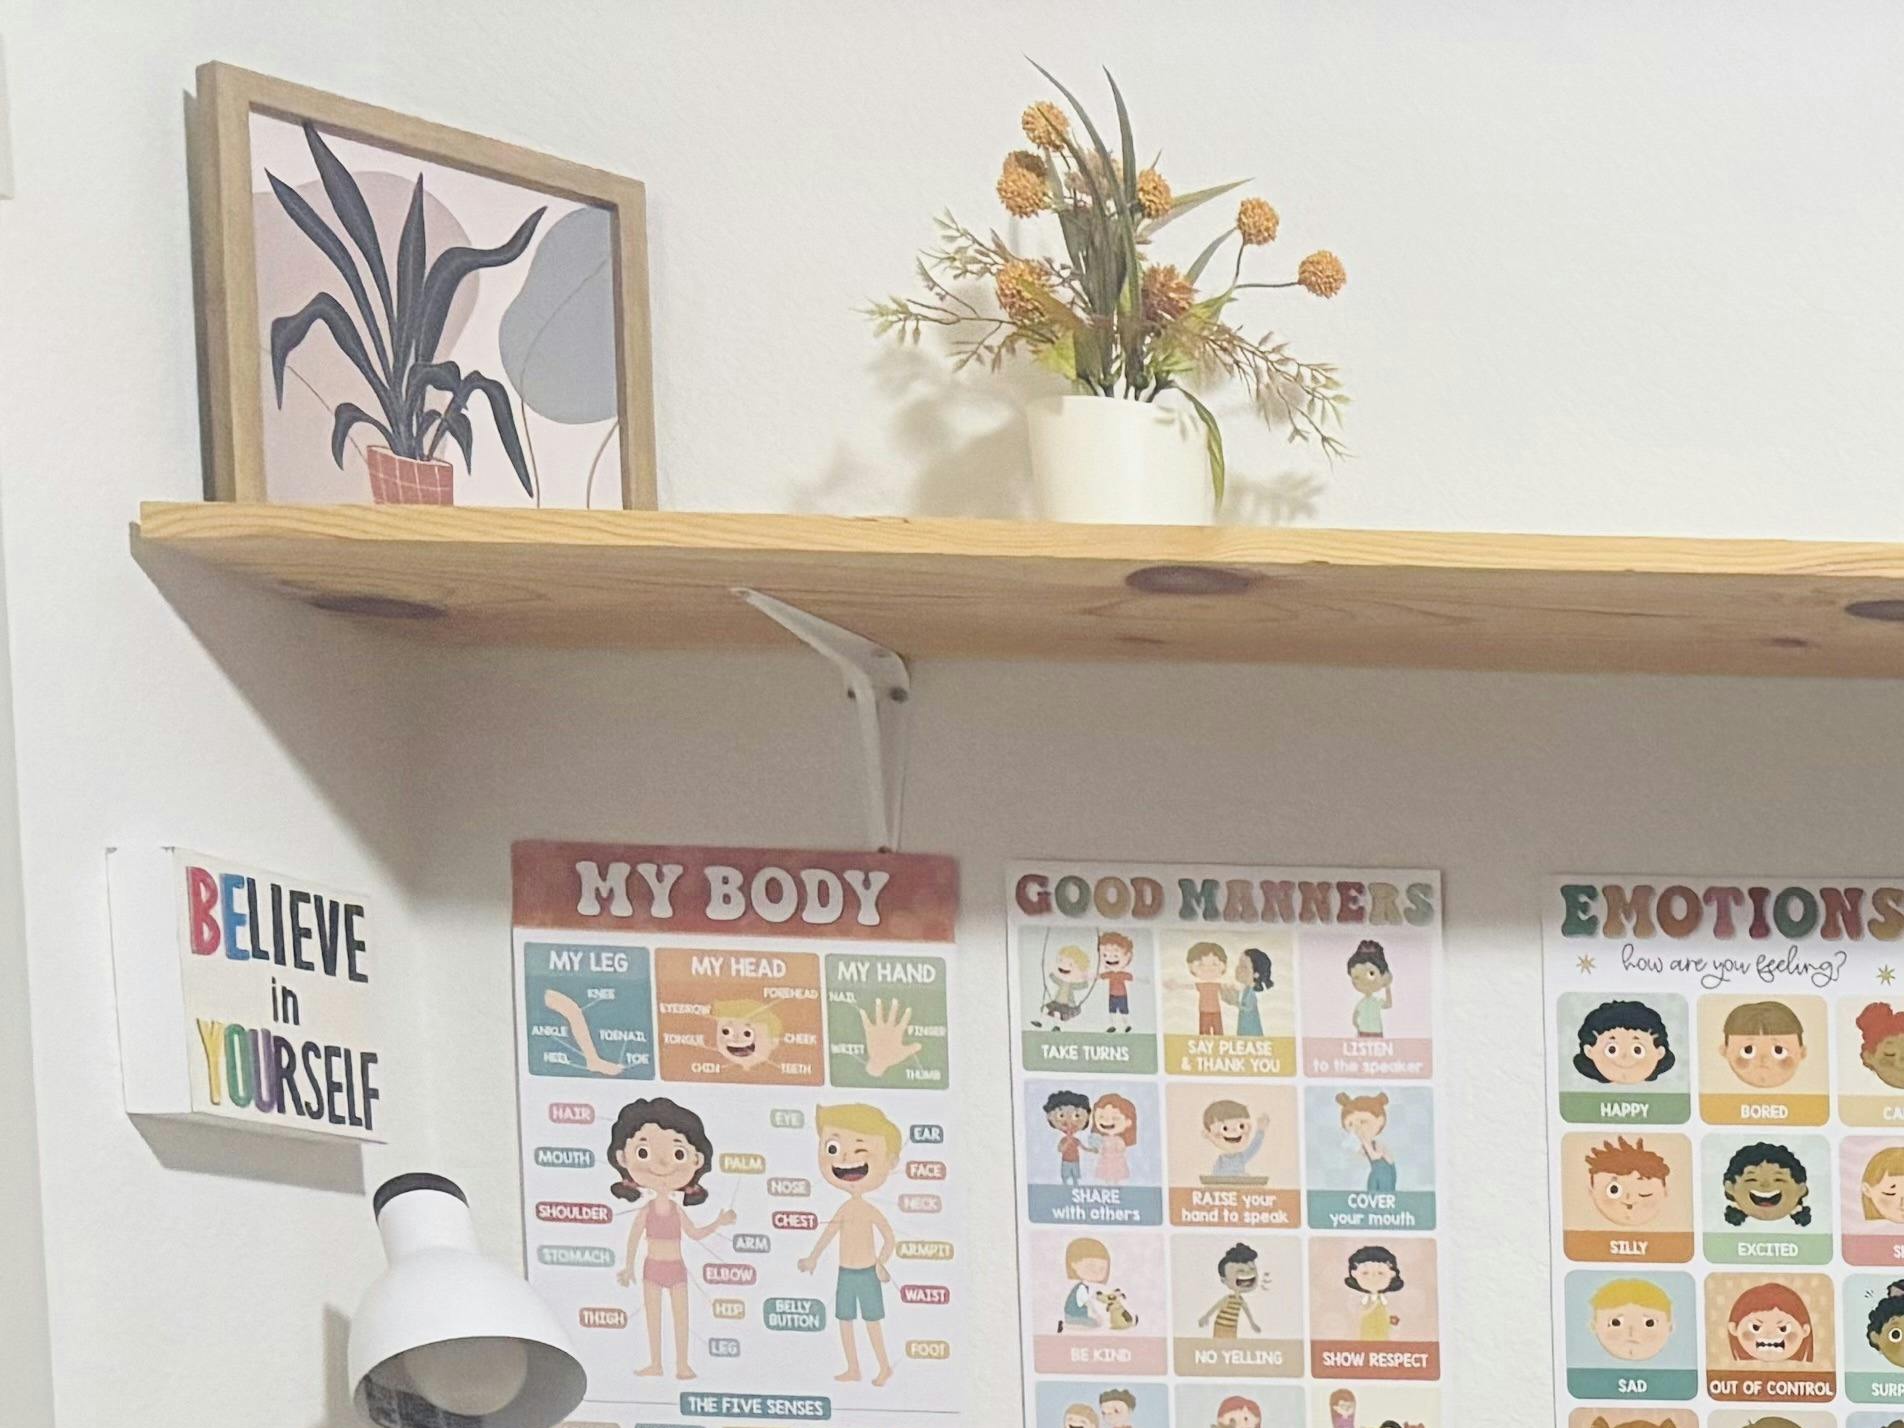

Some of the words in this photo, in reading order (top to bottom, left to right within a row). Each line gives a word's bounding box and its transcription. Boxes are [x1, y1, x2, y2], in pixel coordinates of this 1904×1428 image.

[575, 860, 684, 919] MY
[703, 865, 890, 926] BODY
[1015, 873, 1165, 918] GOOD
[1177, 878, 1435, 927] MANNERS
[186, 866, 369, 983] BELIEVE
[549, 952, 584, 972] MY
[590, 952, 629, 973] LEG
[691, 957, 726, 977] MY
[730, 958, 786, 978] HEAD
[838, 961, 869, 982] MY
[876, 963, 936, 984] HAND
[271, 976, 299, 1025] in
[1041, 1044, 1078, 1060] TAKE
[1083, 1046, 1129, 1061] TURNS
[196, 1018, 380, 1130] YOURSELF
[1600, 1103, 1649, 1118] HAPPY
[1741, 1104, 1788, 1119] BORED
[538, 1150, 591, 1165] MOUTH
[538, 1204, 608, 1221] SHOULDER
[775, 1213, 814, 1229] CHEST
[1609, 1241, 1648, 1256] SILLY
[1738, 1242, 1798, 1257] EXCITED
[1322, 1352, 1365, 1366] SHOW
[1369, 1353, 1428, 1369] RESPECT
[1618, 1379, 1647, 1393] SAD
[1710, 1380, 1738, 1395] OUT
[1743, 1381, 1762, 1395] OF
[1766, 1380, 1834, 1396] CONTROL
[688, 1397, 717, 1412] THE
[721, 1399, 762, 1414] FIVE
[767, 1400, 823, 1416] SENSES
